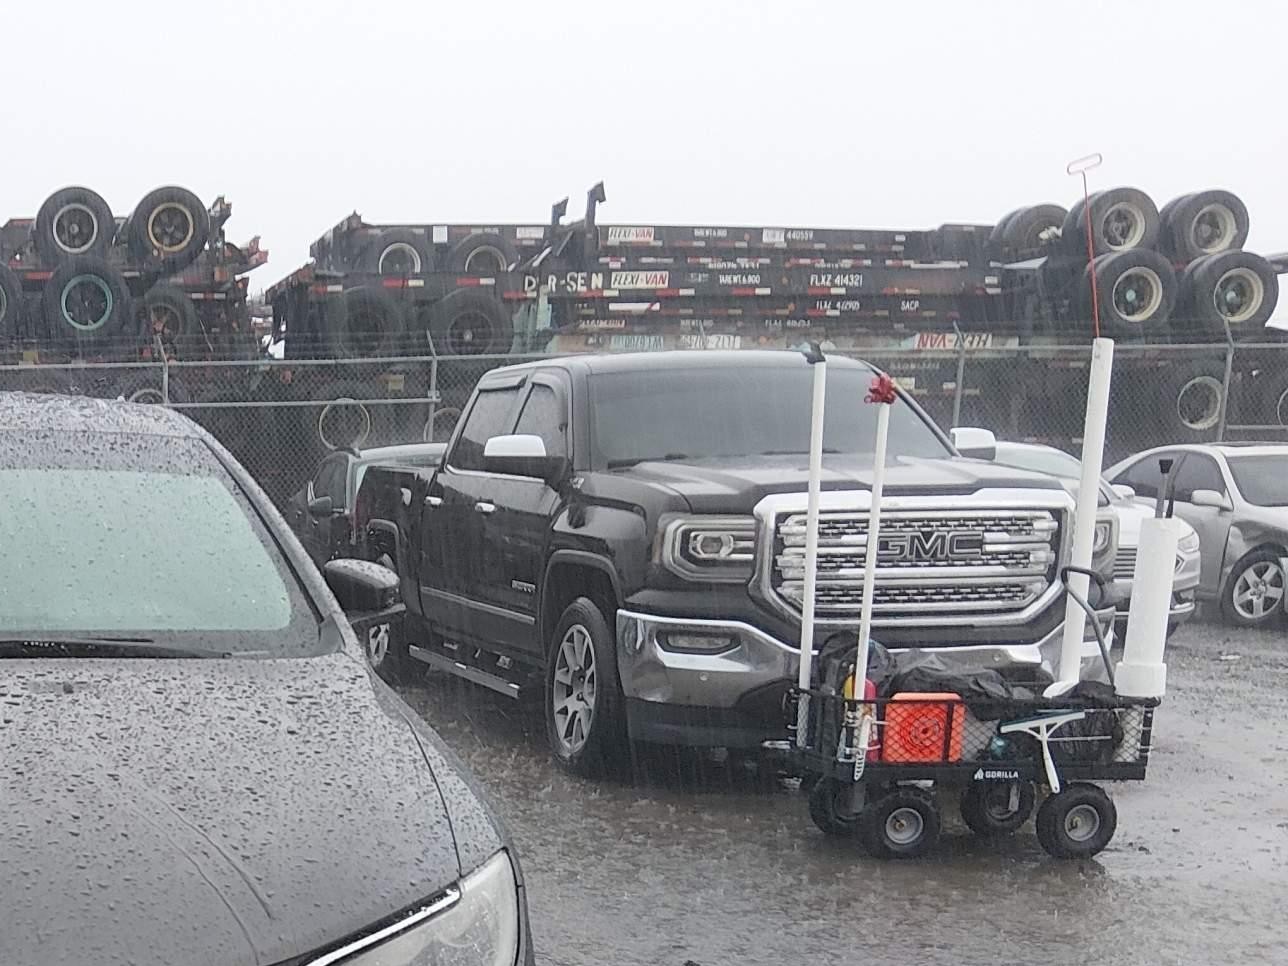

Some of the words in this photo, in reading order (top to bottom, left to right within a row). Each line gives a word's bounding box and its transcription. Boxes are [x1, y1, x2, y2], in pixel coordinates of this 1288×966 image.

[613, 272, 668, 287] FLEXI-VAN
[810, 275, 832, 286] FLXZ
[834, 274, 862, 287] 414321
[900, 301, 920, 311] SACP
[874, 531, 984, 560] GMC
[985, 770, 1019, 779] GORILLA
